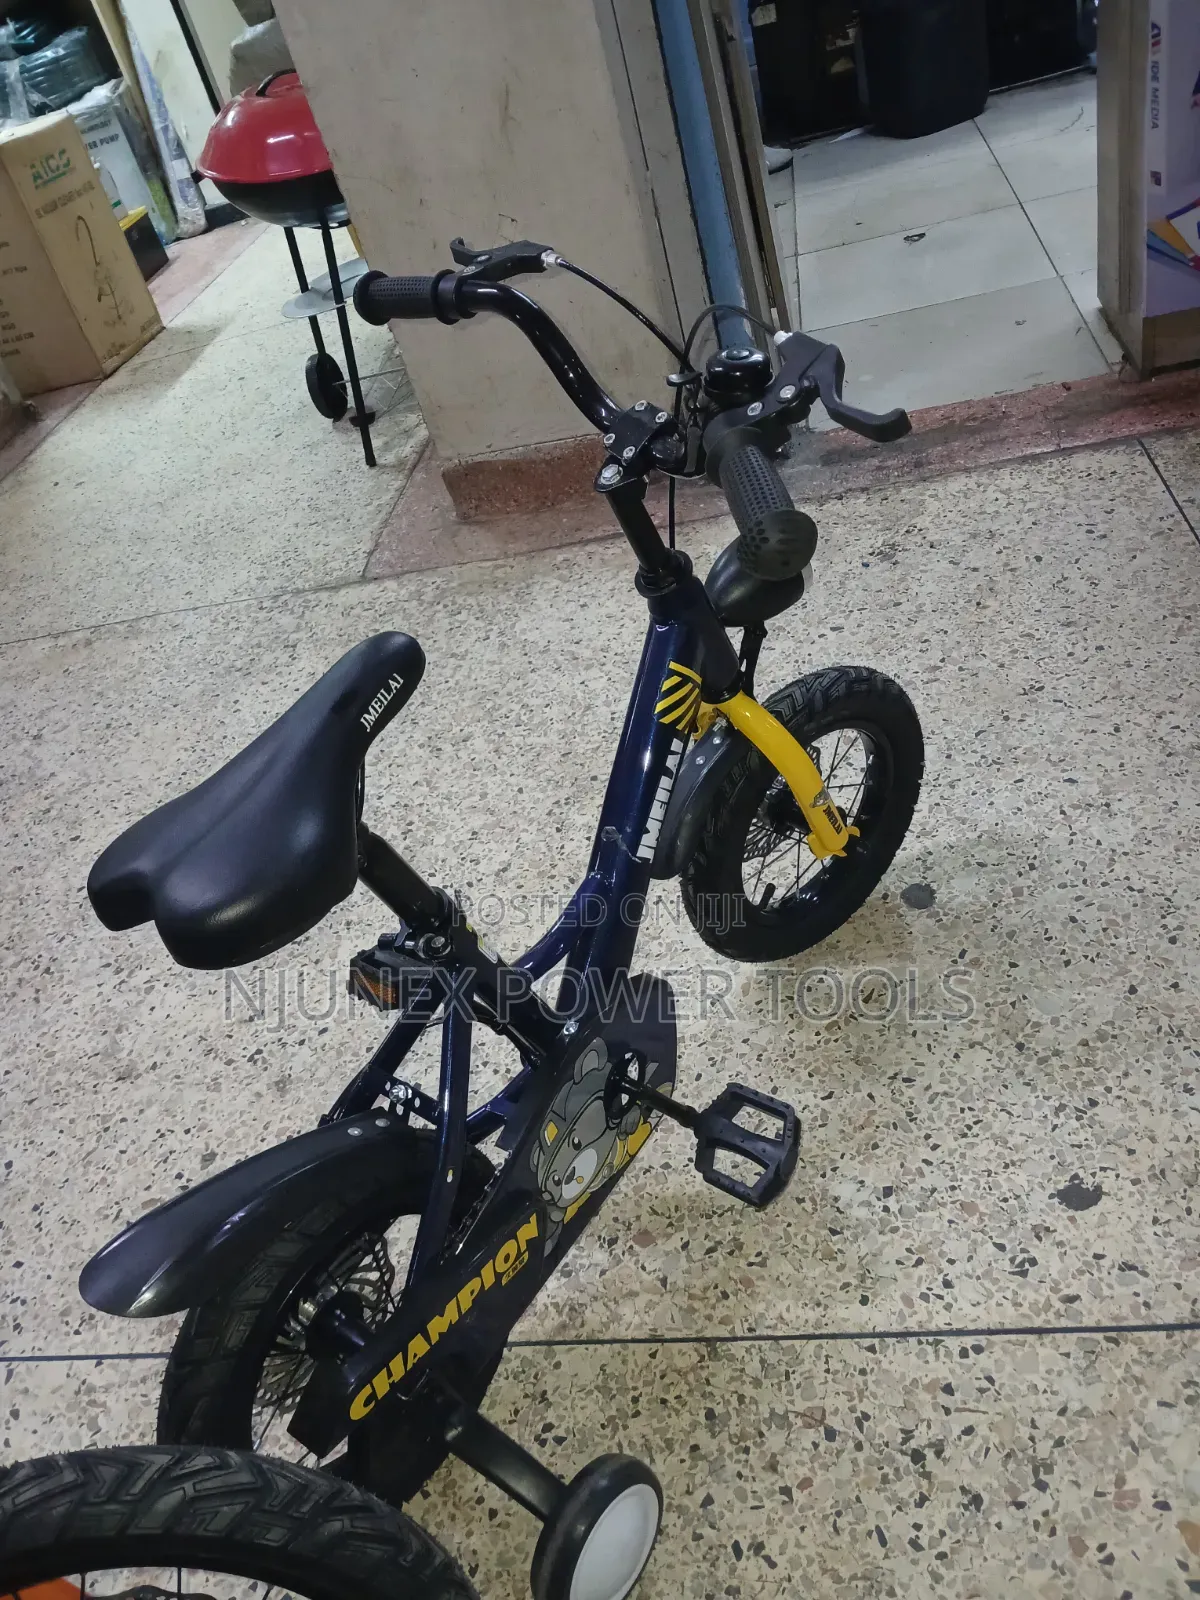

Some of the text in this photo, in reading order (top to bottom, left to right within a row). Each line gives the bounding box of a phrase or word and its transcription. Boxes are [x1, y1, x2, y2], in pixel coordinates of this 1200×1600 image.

[1150, 87, 1160, 130] MEDIA
[99, 133, 119, 146] PUMP
[360, 673, 404, 733] JMEILAI
[349, 1212, 539, 1421] CHAMPION
